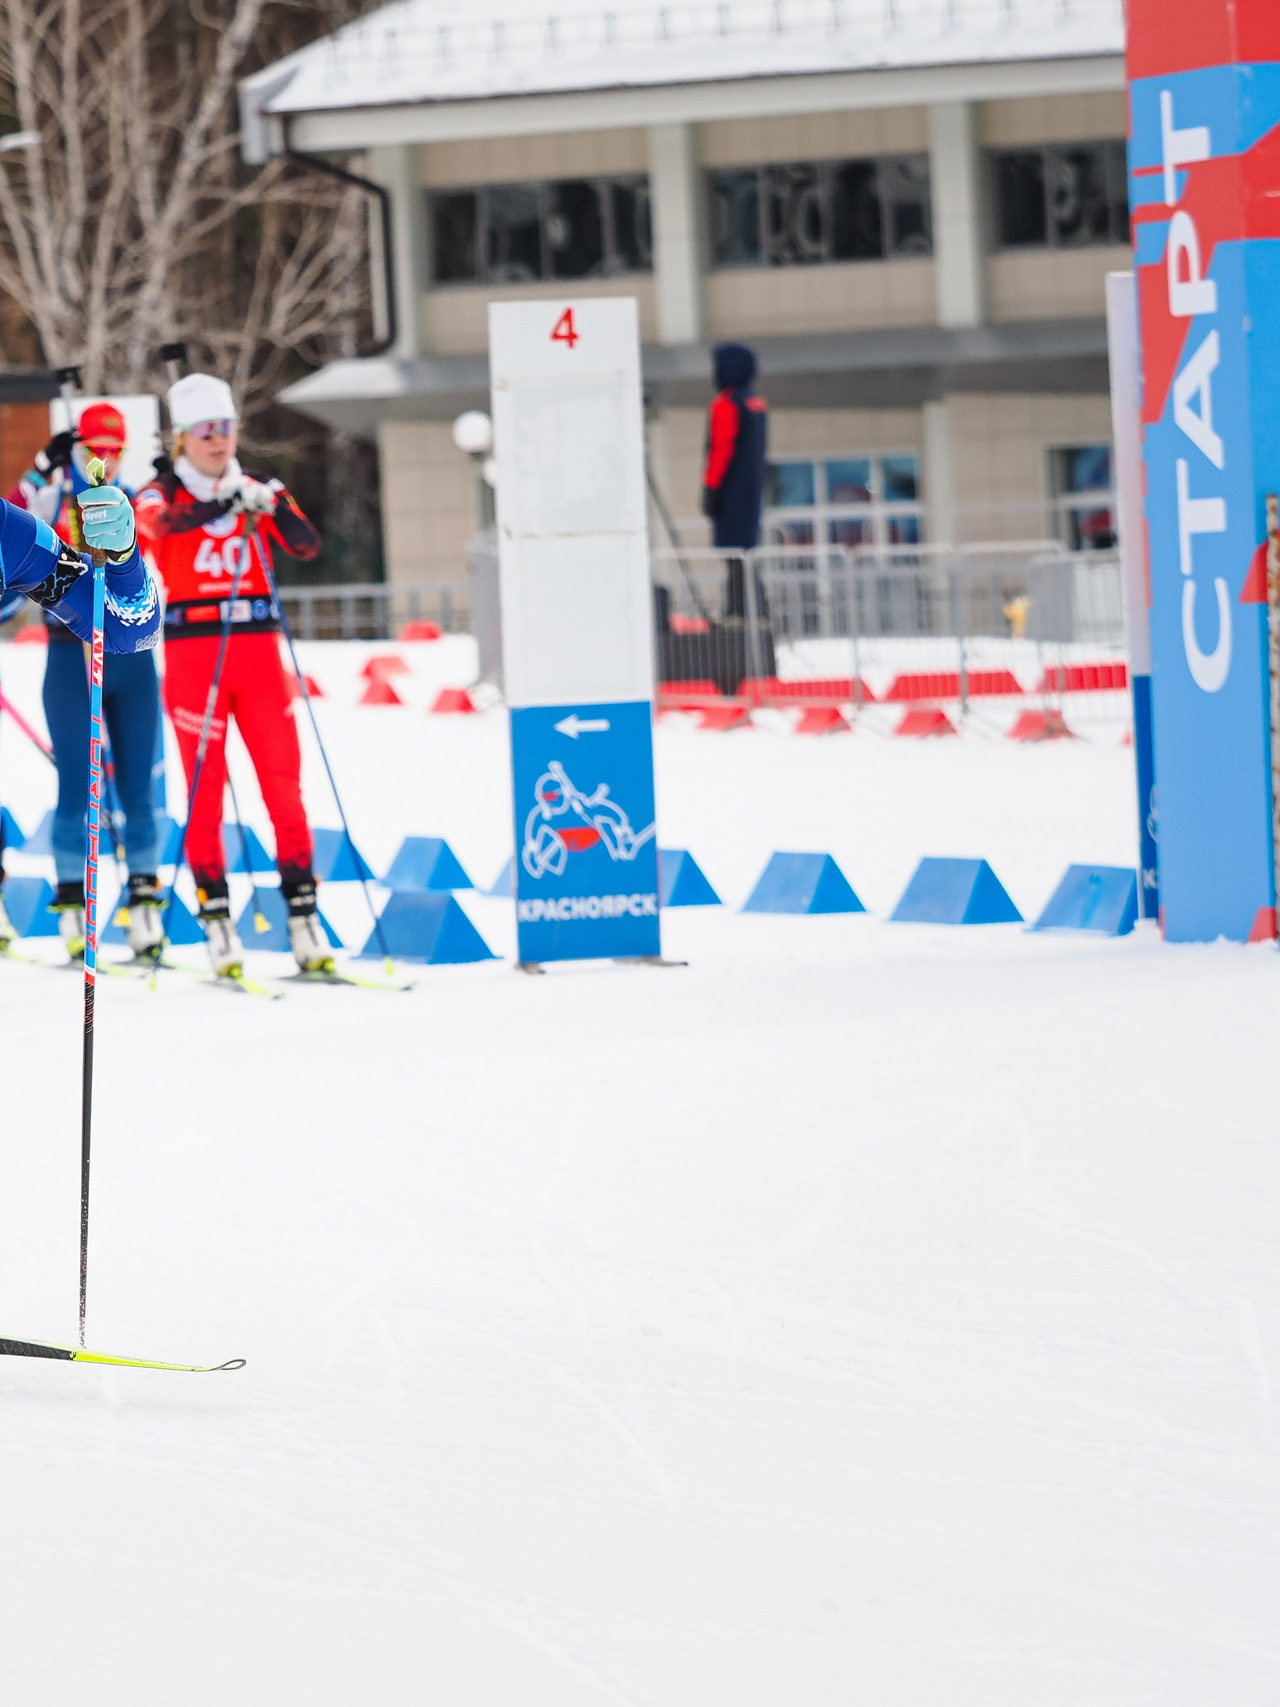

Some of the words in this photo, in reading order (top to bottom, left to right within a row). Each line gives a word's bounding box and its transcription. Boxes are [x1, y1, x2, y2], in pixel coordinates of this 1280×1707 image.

[551, 307, 578, 348] 4
[1161, 90, 1231, 692] СТАРТ
[194, 536, 252, 578] 40
[518, 892, 658, 922] КРАСНОЯРСК
